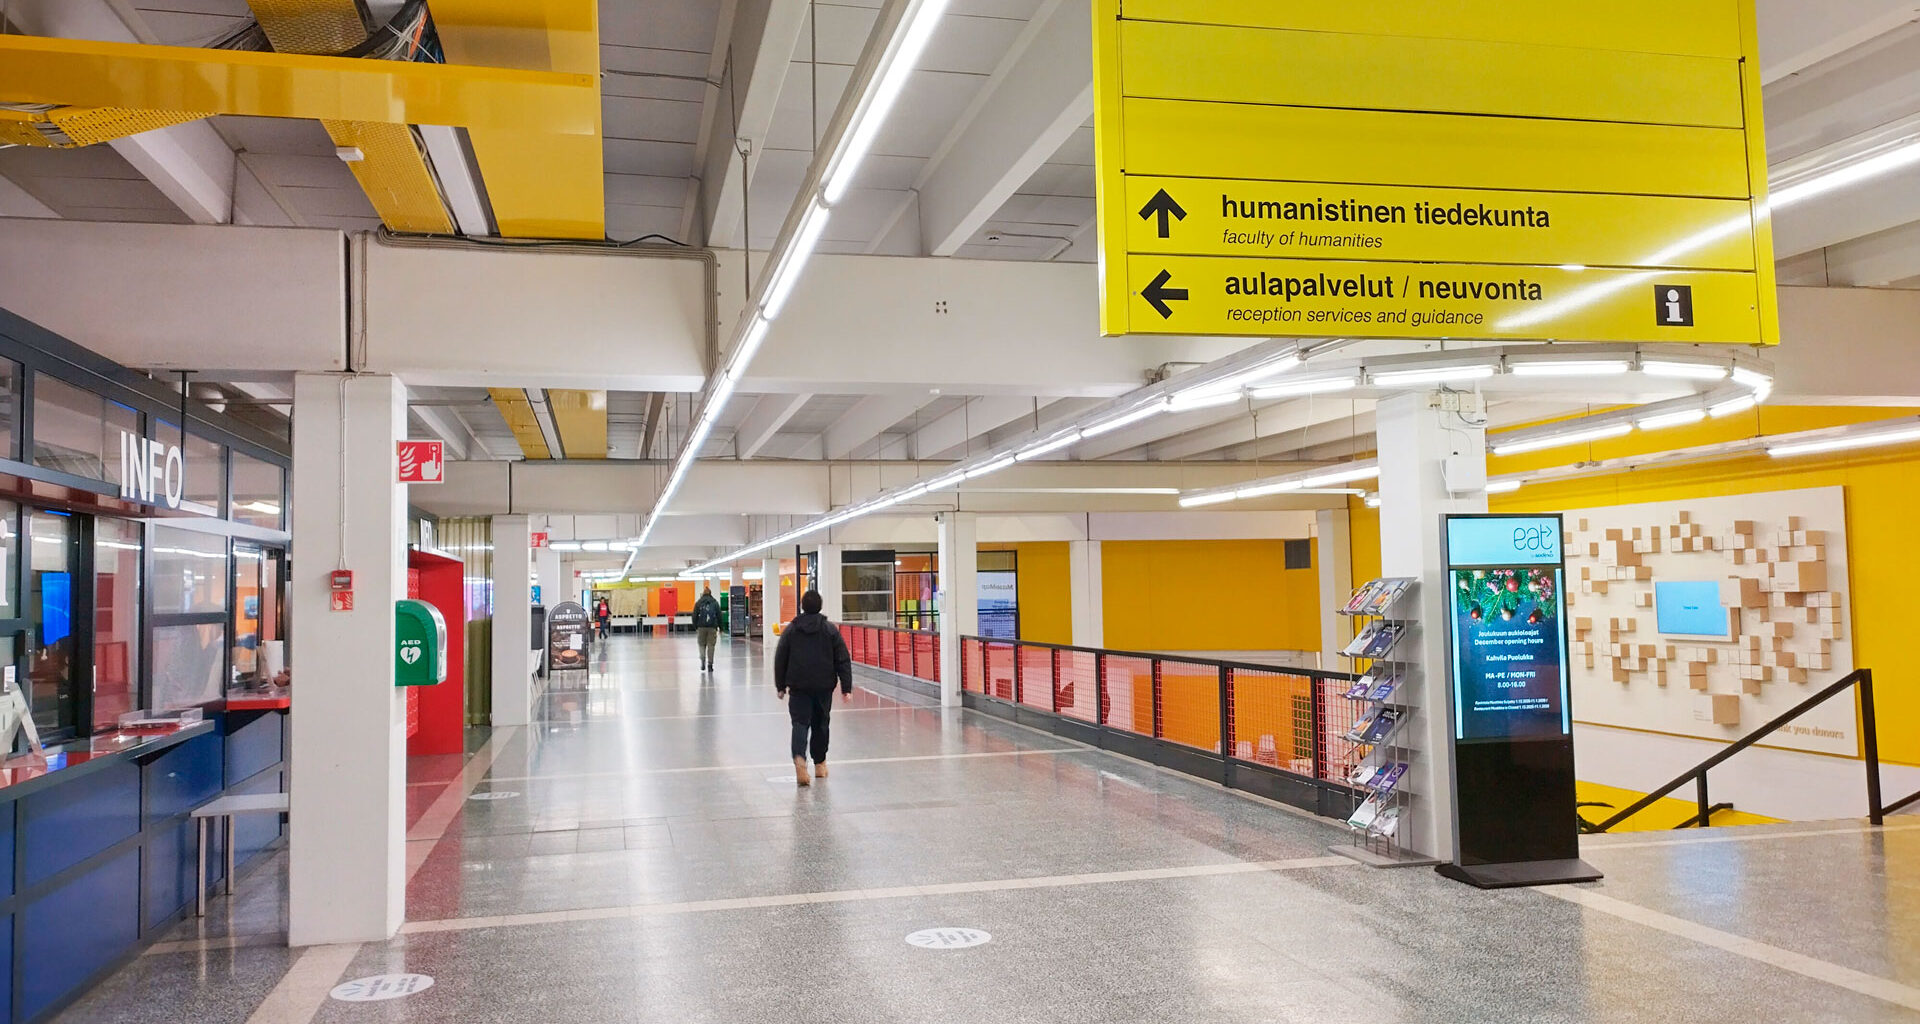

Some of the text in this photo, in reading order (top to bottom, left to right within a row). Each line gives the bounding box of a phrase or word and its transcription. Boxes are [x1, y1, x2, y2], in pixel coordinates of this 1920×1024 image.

[1221, 194, 1550, 228] humanistinen tiedekunta
[1222, 229, 1383, 249] faculty of humanities
[1225, 271, 1543, 302] aulapalvelut / neuvonta
[1226, 306, 1484, 327] reception services and guidance
[120, 430, 183, 509] INFO
[1513, 523, 1553, 551] eat
[1504, 638, 1527, 646] opening
[1793, 725, 1810, 735] you
[1811, 726, 1844, 739] donors
